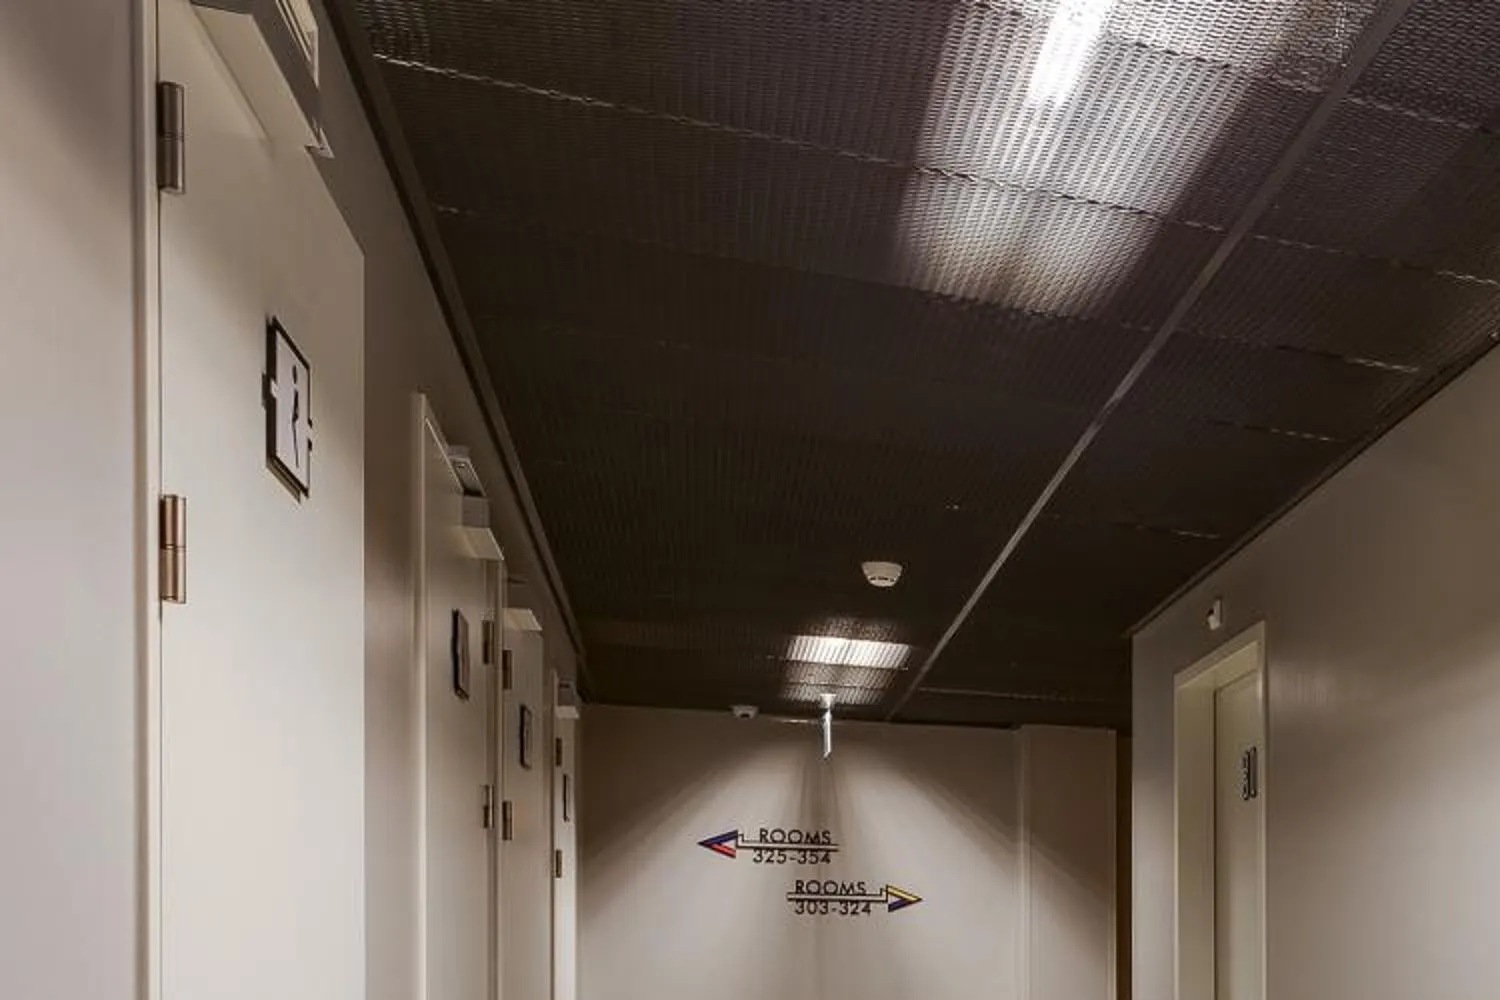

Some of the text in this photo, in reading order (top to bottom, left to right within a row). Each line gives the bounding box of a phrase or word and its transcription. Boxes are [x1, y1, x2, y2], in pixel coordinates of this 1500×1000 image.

[759, 828, 832, 845] ROOMS
[752, 848, 832, 865] 325-354
[795, 879, 868, 896] ROOMS
[794, 900, 872, 916] 303-324
